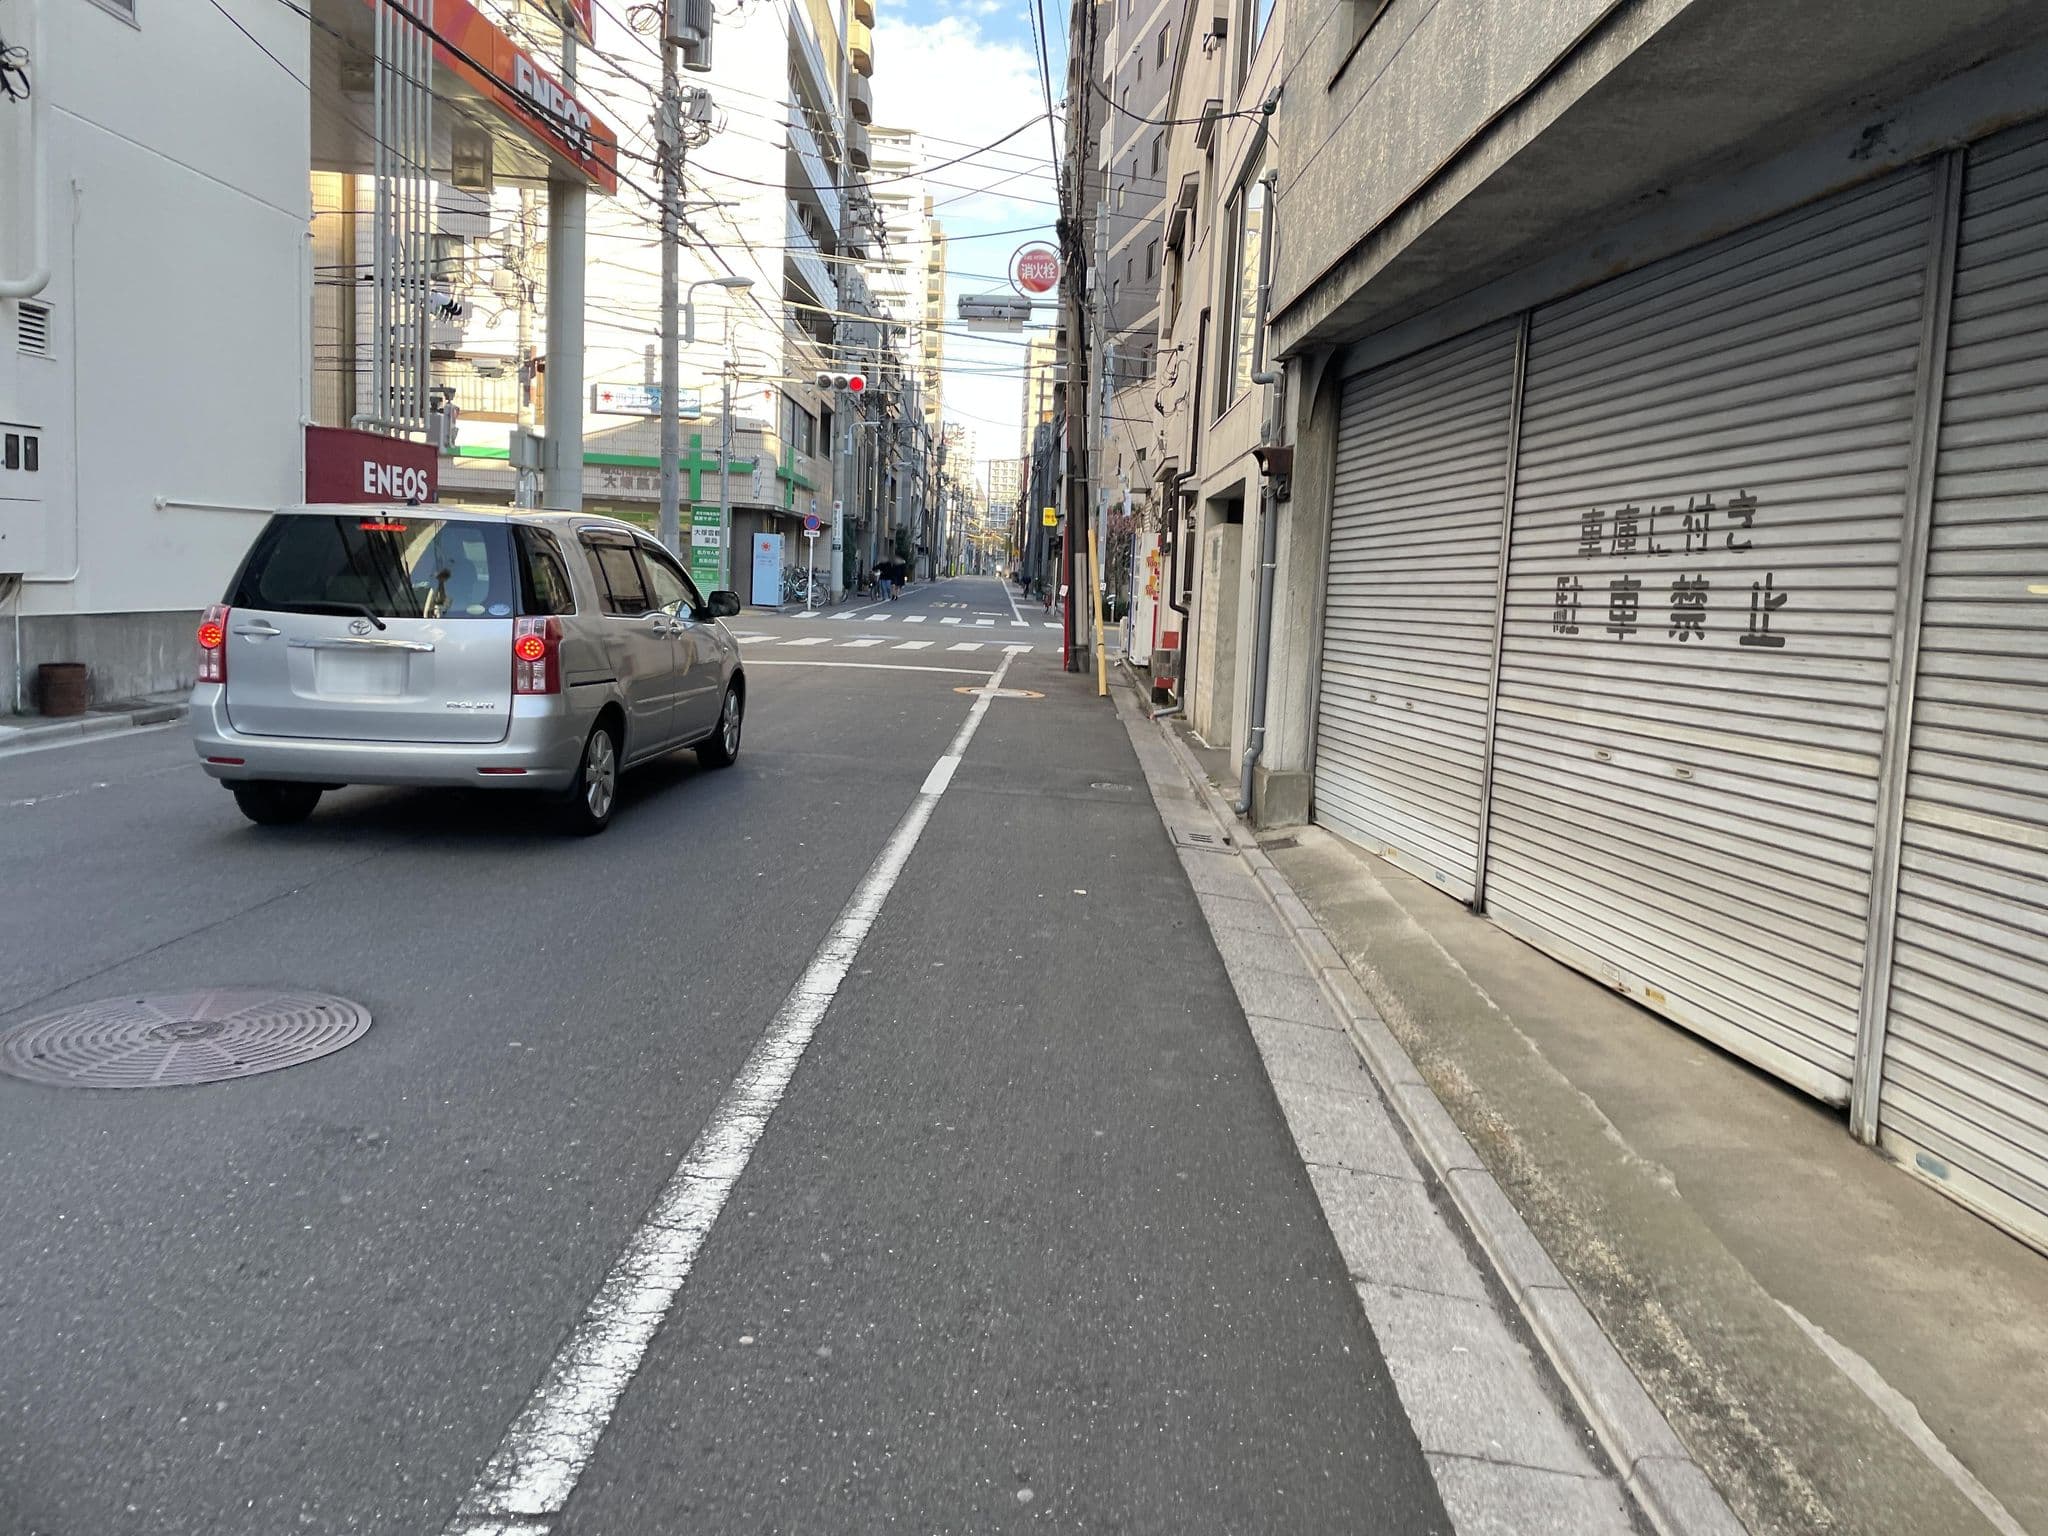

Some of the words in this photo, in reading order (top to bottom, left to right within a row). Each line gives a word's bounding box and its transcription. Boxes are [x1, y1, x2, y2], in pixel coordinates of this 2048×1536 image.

[515, 54, 592, 161] ENEOS
[1021, 262, 1056, 280] 消火栓
[363, 460, 428, 501] ENEOS
[1552, 573, 1788, 648] 駐車禁止
